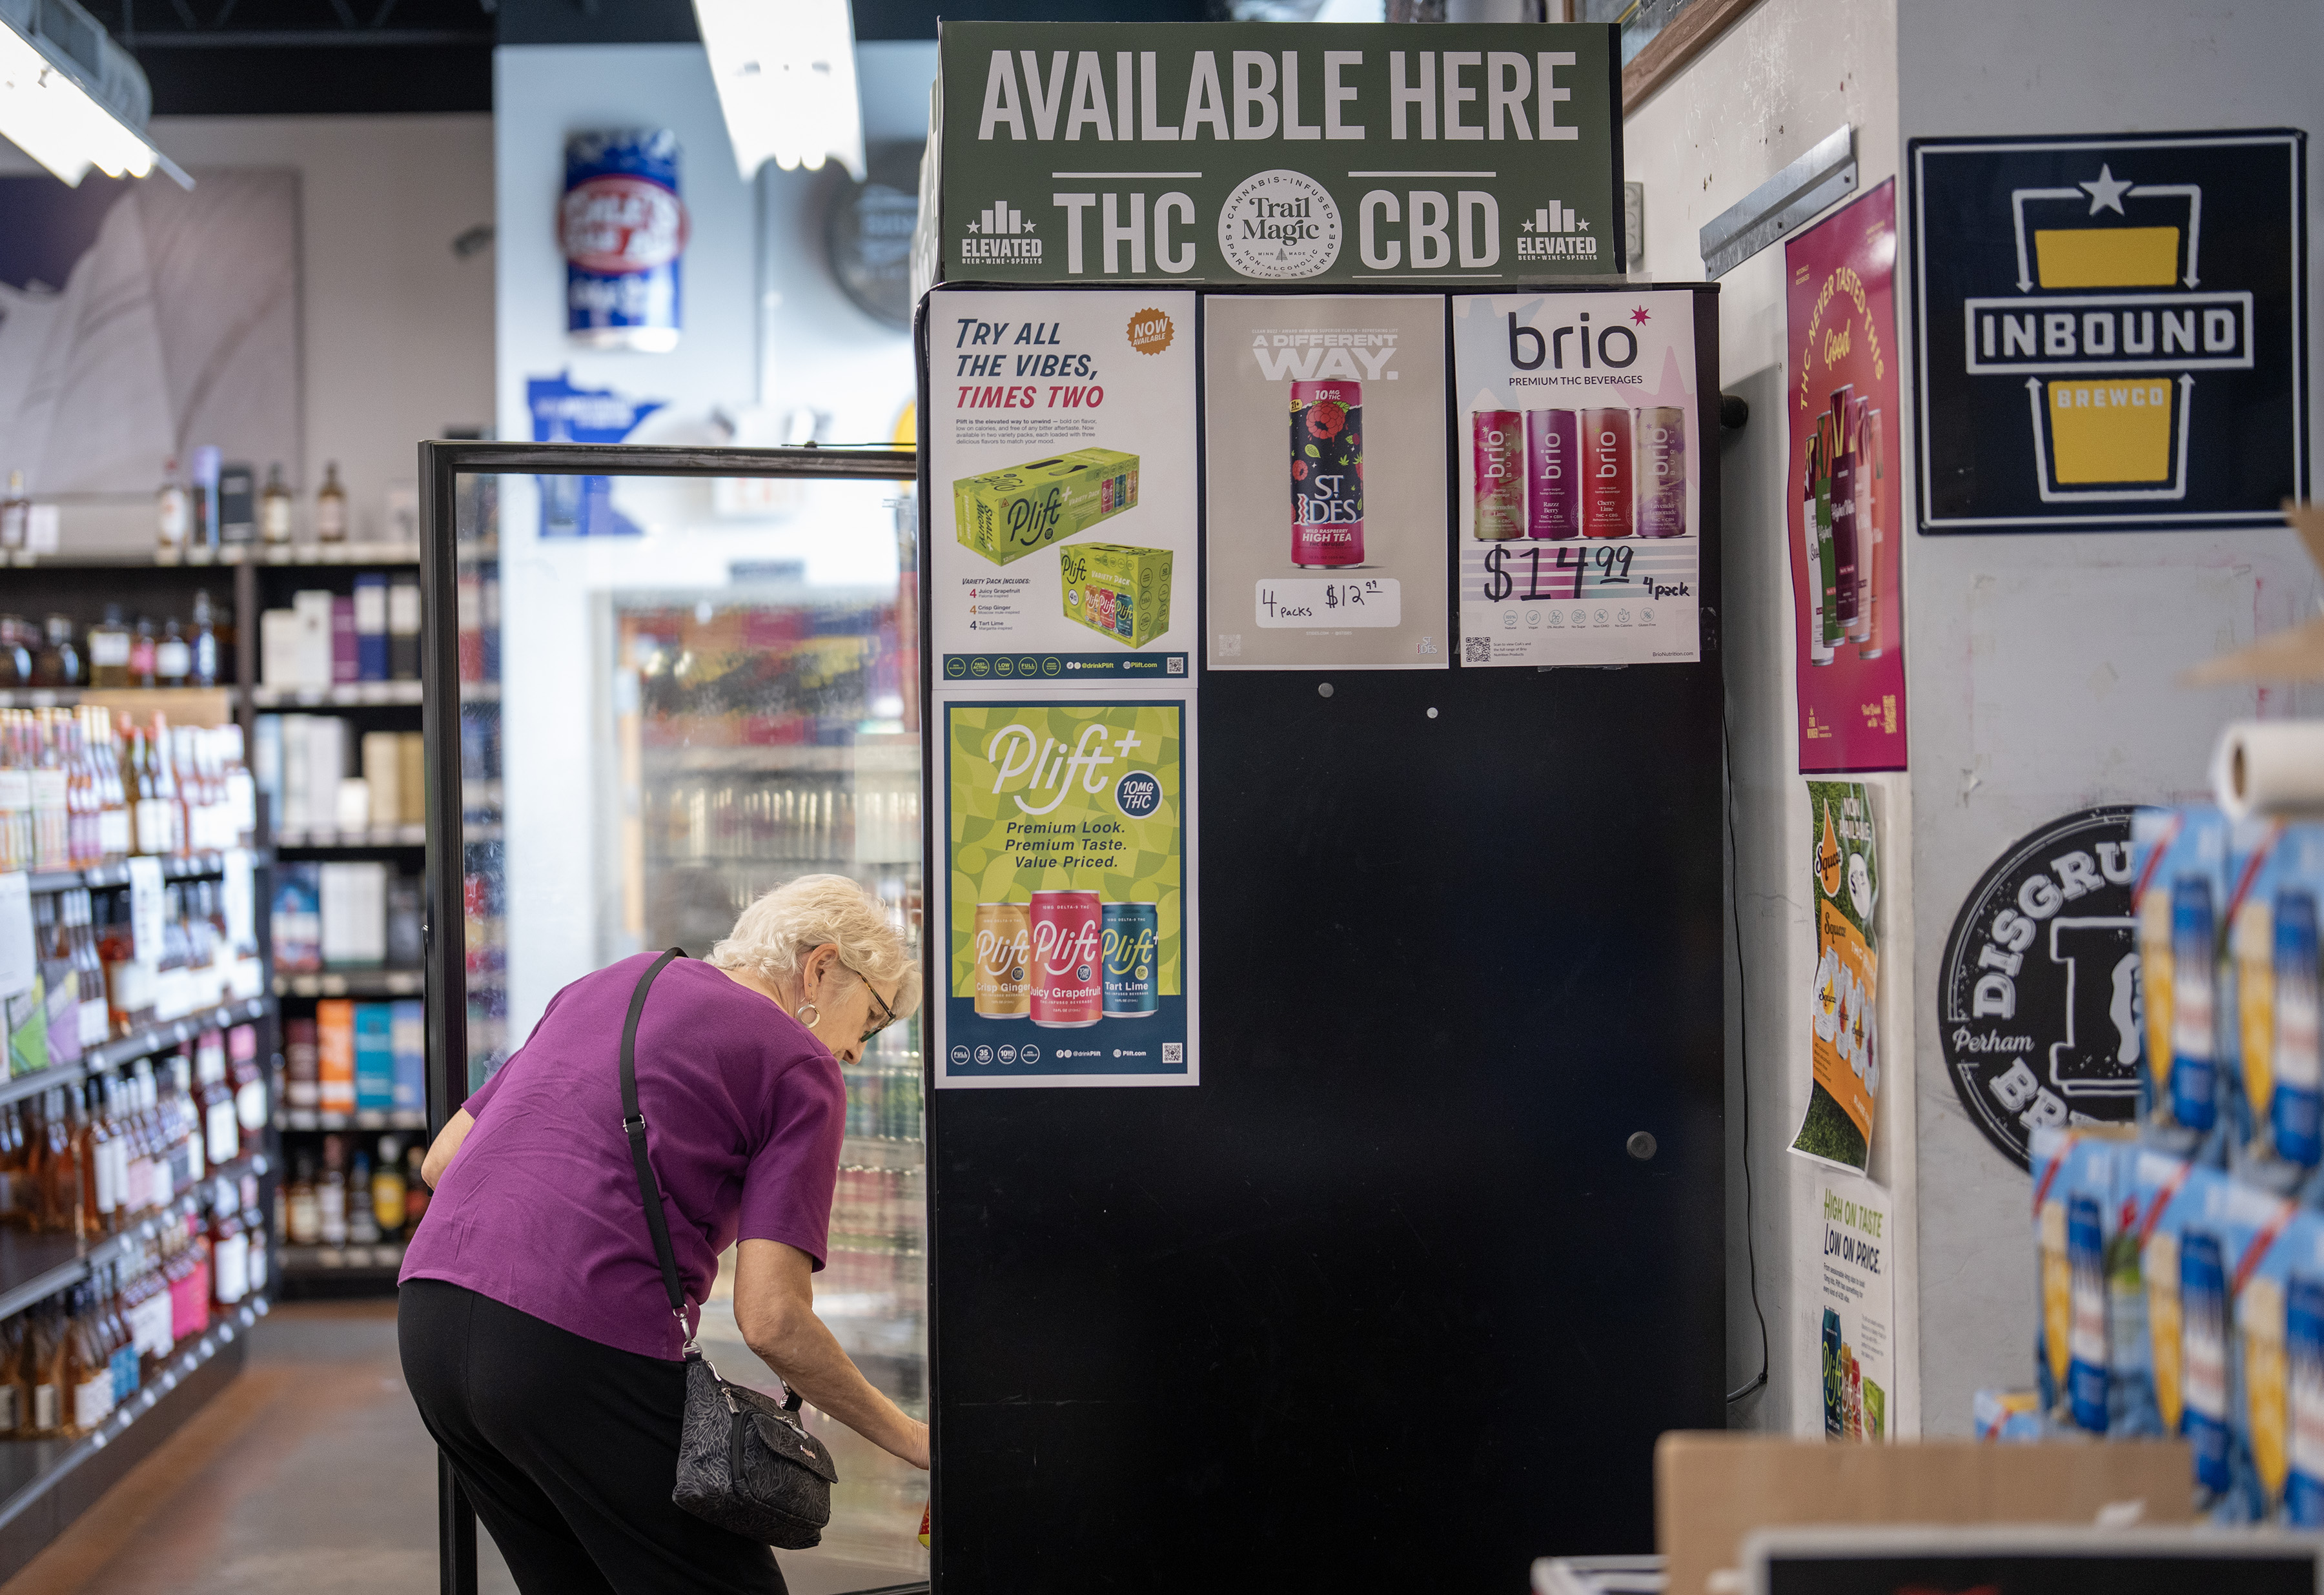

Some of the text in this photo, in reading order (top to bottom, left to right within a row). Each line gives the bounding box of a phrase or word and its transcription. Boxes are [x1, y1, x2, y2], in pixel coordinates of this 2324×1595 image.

[977, 50, 1578, 141] AVAILABLE HERE
[1227, 176, 1334, 219] CANNABIS-INFUSED
[1249, 197, 1311, 218] Trail
[1053, 192, 1196, 274] THC
[1241, 219, 1320, 246] Magic
[1359, 189, 1500, 270] CBD
[962, 239, 1042, 257] ELEVATED
[1226, 234, 1336, 278] SPARKLING BEVERAGE
[1517, 237, 1596, 254] ELEVATED
[1244, 249, 1318, 270] NON-ALCOHOLIC
[1014, 323, 1061, 345] ALL
[1133, 332, 1166, 346] AVAILABLE
[1134, 318, 1168, 338] NOW
[1800, 267, 1884, 410] THC NEVER TASTED THIS
[1983, 309, 2236, 358] INBOUND
[1252, 334, 1398, 347] A DIFFERENT
[1508, 312, 1638, 371] brio
[956, 354, 1099, 380] THE VIBES,
[1252, 347, 1399, 381] WAY.
[1509, 376, 1643, 386] PREMIUM THC BEVERAGES
[957, 385, 1105, 408] TIMES TWO
[1315, 390, 1328, 400] 10
[2057, 387, 2164, 409] BREWCO
[1484, 431, 1505, 478] brio
[1541, 432, 1562, 479] brio
[1596, 431, 1617, 478] brio
[1647, 428, 1668, 476] brio
[1303, 533, 1352, 542] HIGH TEA
[1061, 555, 1087, 584] Plift
[1092, 571, 1113, 581] VARIETY
[1114, 576, 1130, 585] PACK
[970, 589, 977, 598] 4
[1643, 576, 1689, 600] 4 pack
[970, 605, 977, 615] 4
[1263, 589, 1277, 618] 4
[970, 620, 977, 630] 4
[1123, 780, 1154, 795] 10MG
[1123, 795, 1151, 809] THC
[1006, 821, 1125, 833] Premium Look.
[1005, 838, 1126, 851] Premium Taste.
[1015, 855, 1118, 868] Value Priced.
[977, 982, 1030, 993] Crisp Ginger
[1030, 986, 1101, 999] Juicy Grapefruit
[1105, 981, 1148, 991] Tart Lime
[1952, 1024, 2035, 1053] Perham
[1824, 1188, 1883, 1238] HIGH ON TASTE
[1824, 1223, 1842, 1257] LOW
[1843, 1235, 1855, 1263] ON
[1856, 1240, 1881, 1275] PRICE.
